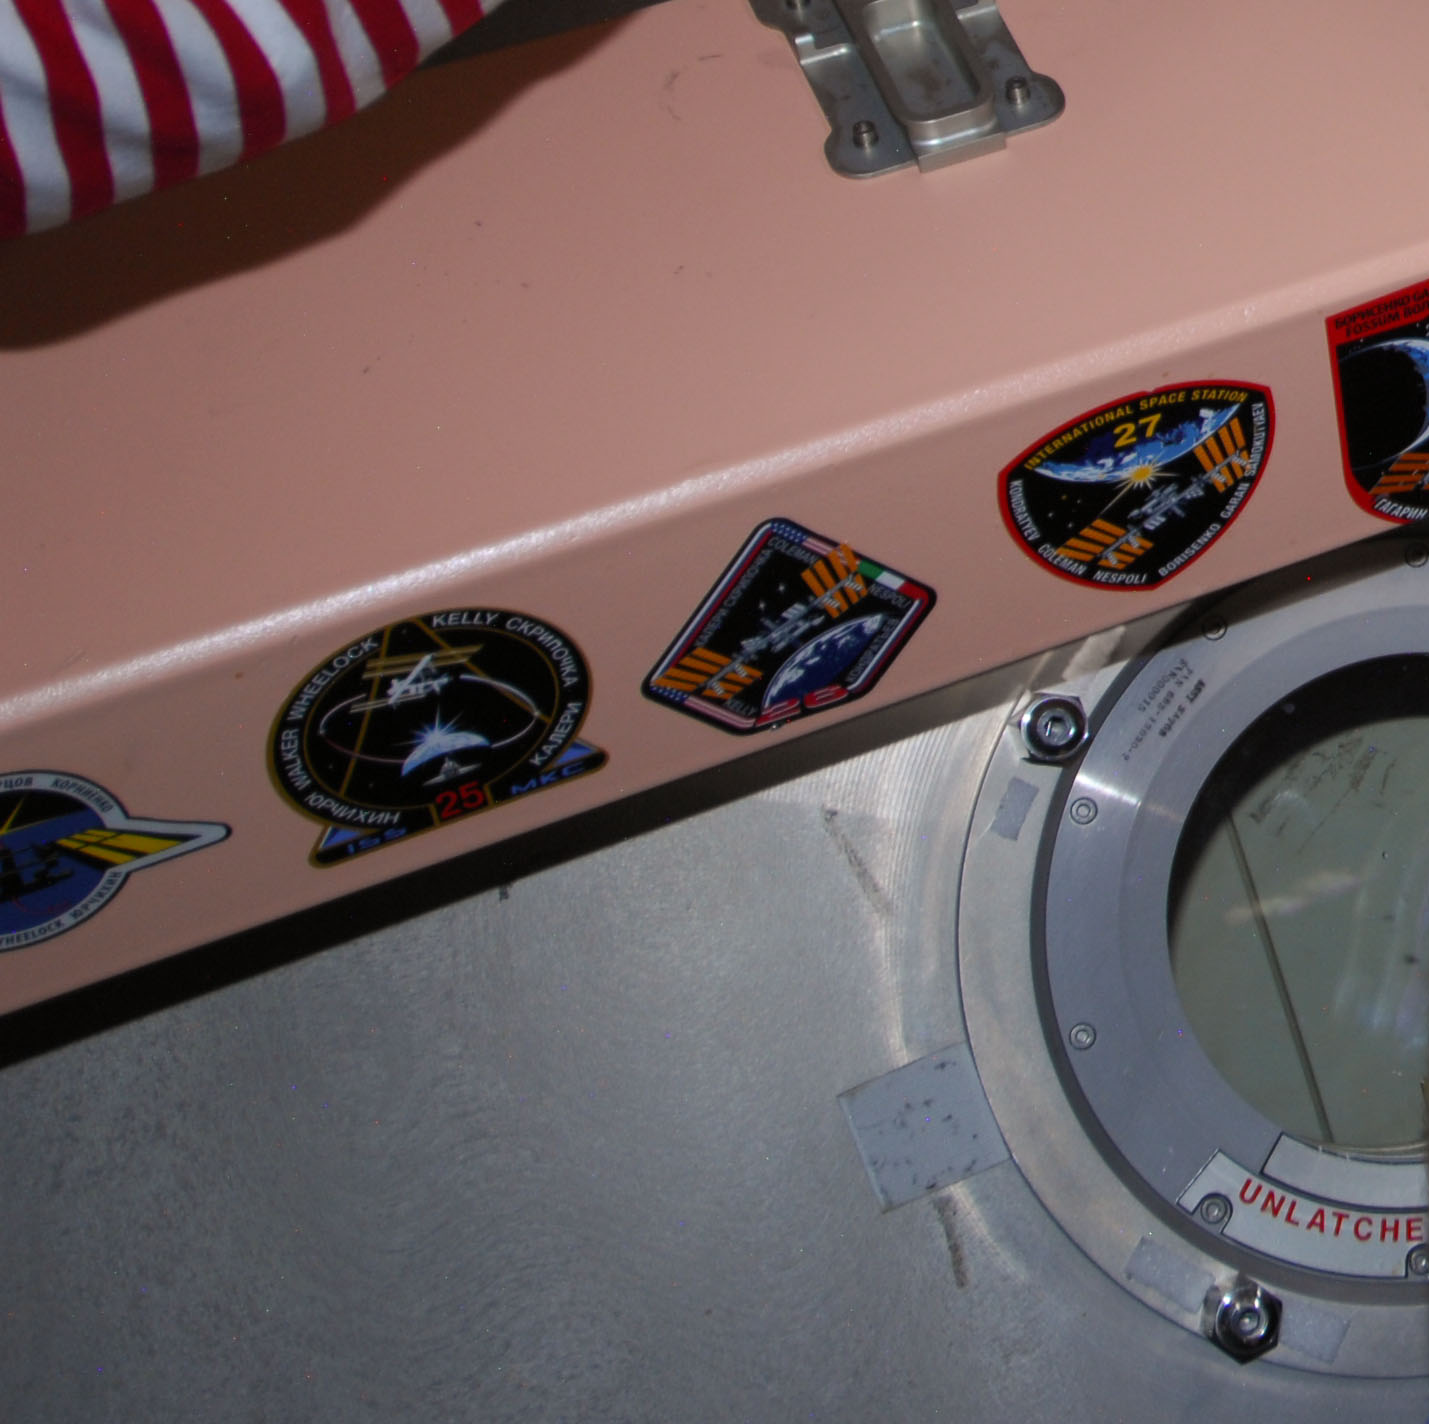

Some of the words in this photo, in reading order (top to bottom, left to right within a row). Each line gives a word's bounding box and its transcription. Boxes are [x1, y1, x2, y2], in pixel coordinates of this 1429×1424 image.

[1023, 404, 1134, 471] INTERNATIONAL
[1138, 389, 1187, 412] SPACE
[1191, 388, 1249, 404] STATION
[1112, 412, 1163, 449] 27
[1008, 478, 1042, 542] KONDRATYEV
[1219, 481, 1251, 520] GARAN
[1373, 496, 1429, 521] ГАГАРИН
[767, 536, 821, 568] COLEMAN
[1037, 543, 1088, 577] COLEMAN
[1157, 522, 1223, 577] BORISENKO
[866, 581, 910, 610] NESPOLI
[1092, 569, 1148, 585] NESPOLI
[431, 610, 499, 628] KELLY
[505, 616, 581, 689] СКРИПОЧКА
[287, 636, 381, 722] WHEELOCK
[723, 697, 759, 718] KELLY
[528, 700, 583, 767] КАЛЕРИ
[281, 729, 313, 792] WALKER
[304, 790, 401, 826] ЮРЧИХИН
[434, 780, 488, 821] 25
[346, 826, 408, 854] ISS
[1239, 1178, 1425, 1244] UNLATCHE
